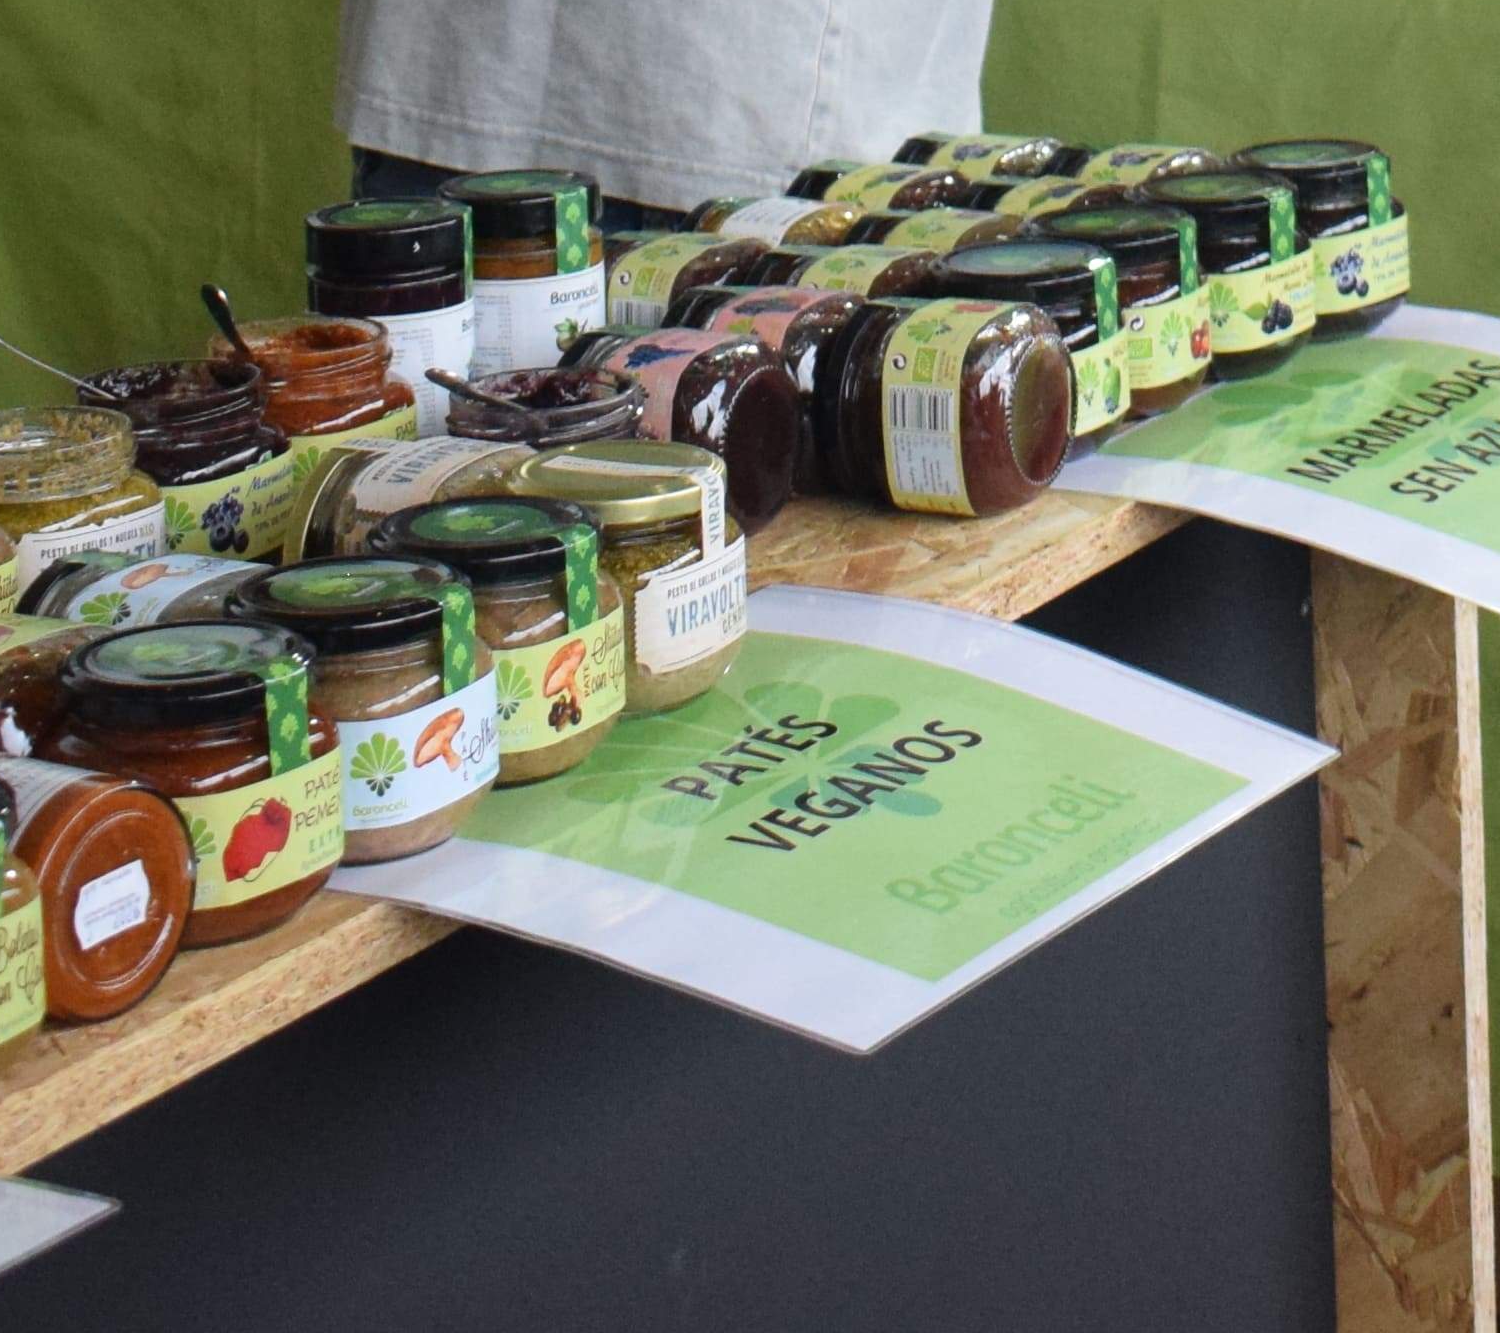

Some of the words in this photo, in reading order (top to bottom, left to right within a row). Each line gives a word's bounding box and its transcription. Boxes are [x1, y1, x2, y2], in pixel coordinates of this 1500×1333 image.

[1389, 457, 1478, 504] SEN
[660, 713, 839, 802] PATÉS
[724, 718, 984, 853] VEGANOS
[884, 773, 1138, 916] Baronceli
